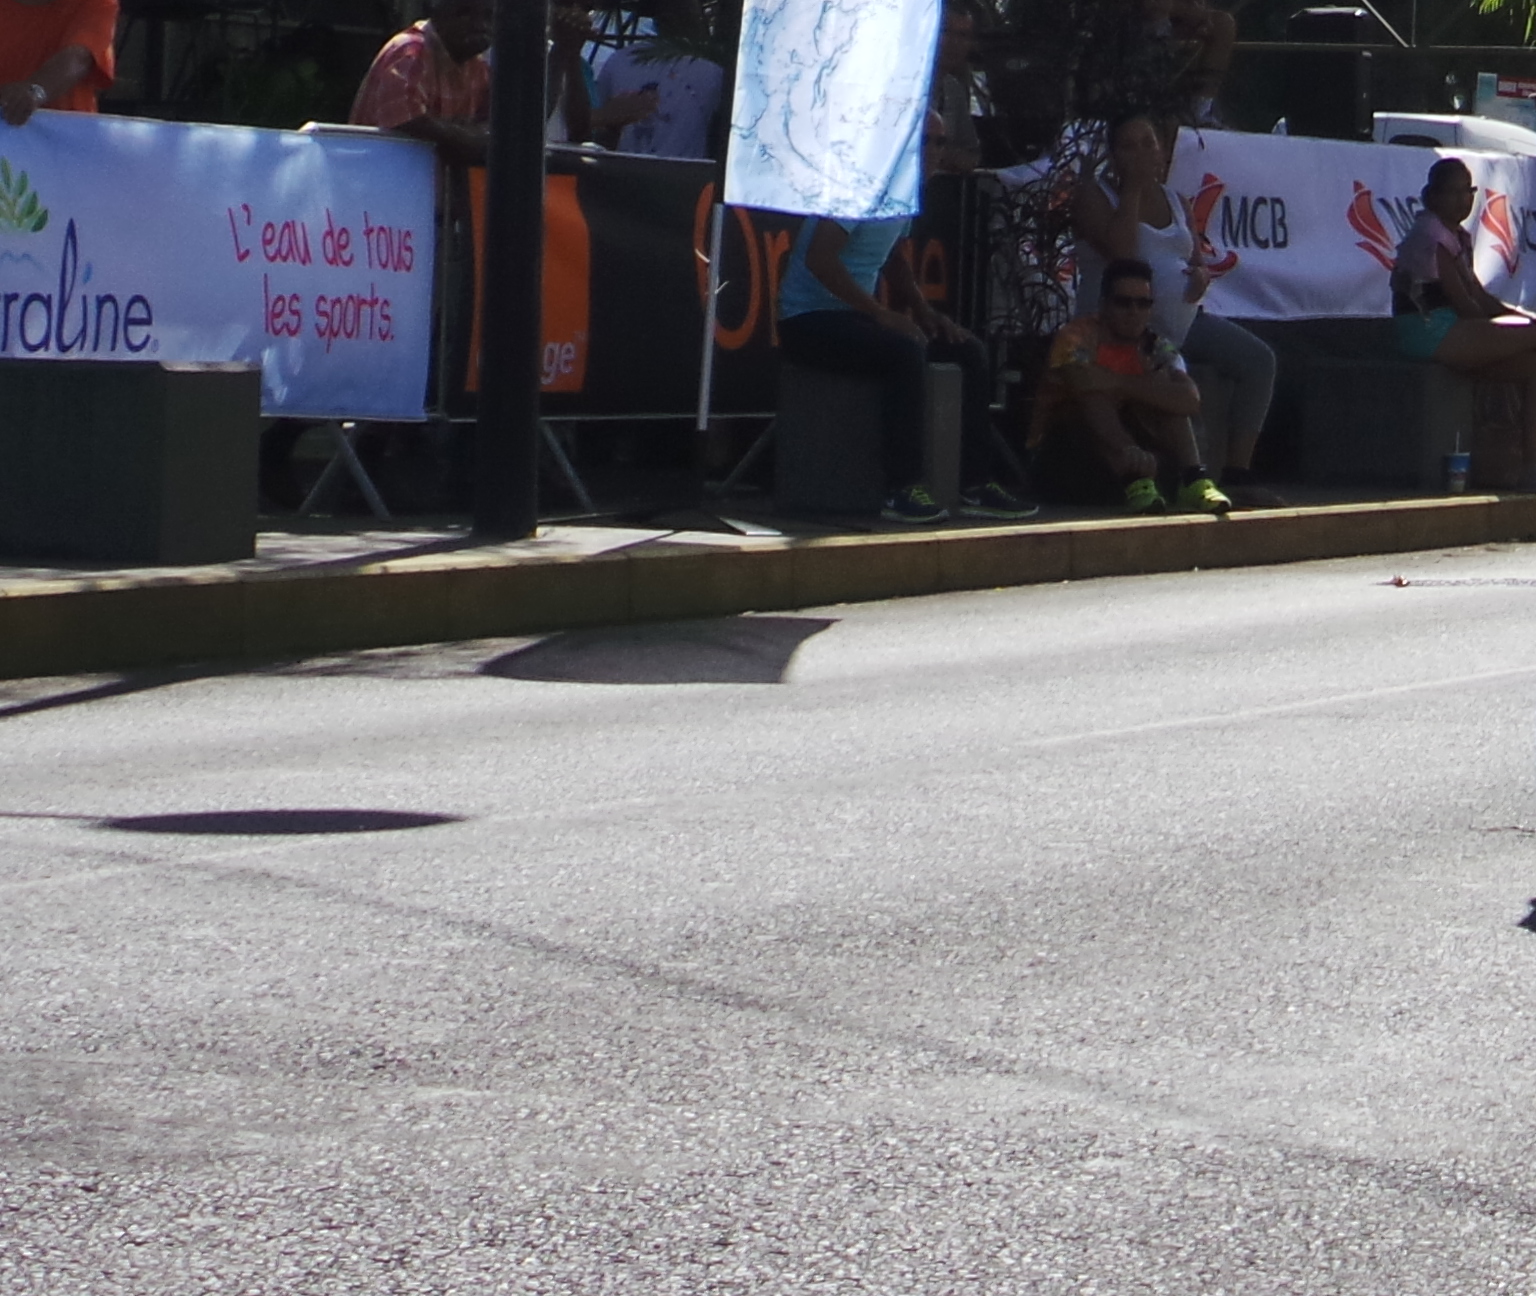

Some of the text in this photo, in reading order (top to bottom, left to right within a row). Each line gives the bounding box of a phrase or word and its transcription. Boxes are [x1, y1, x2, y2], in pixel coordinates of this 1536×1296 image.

[322, 207, 355, 268] de
[363, 210, 415, 273] tous
[1220, 196, 1289, 250] MCB
[0, 217, 153, 353] raline
[263, 272, 396, 354] les sports.
